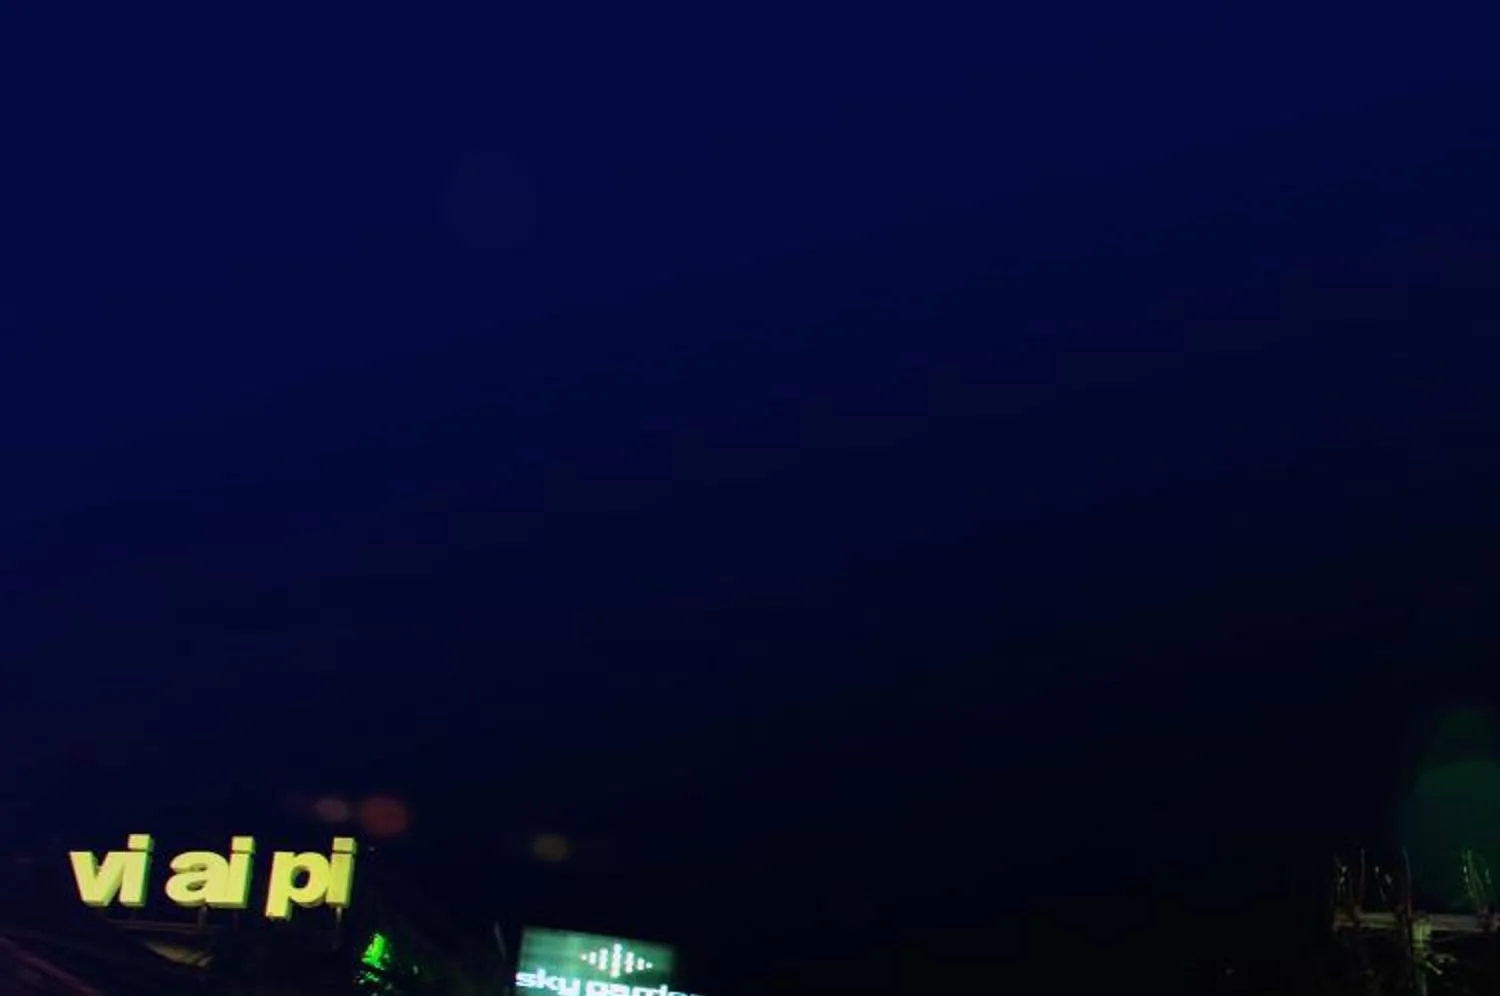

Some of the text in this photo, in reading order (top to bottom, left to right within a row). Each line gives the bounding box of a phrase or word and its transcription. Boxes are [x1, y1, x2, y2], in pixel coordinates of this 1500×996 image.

[69, 833, 357, 921] vi ai pi
[515, 967, 580, 996] sky
